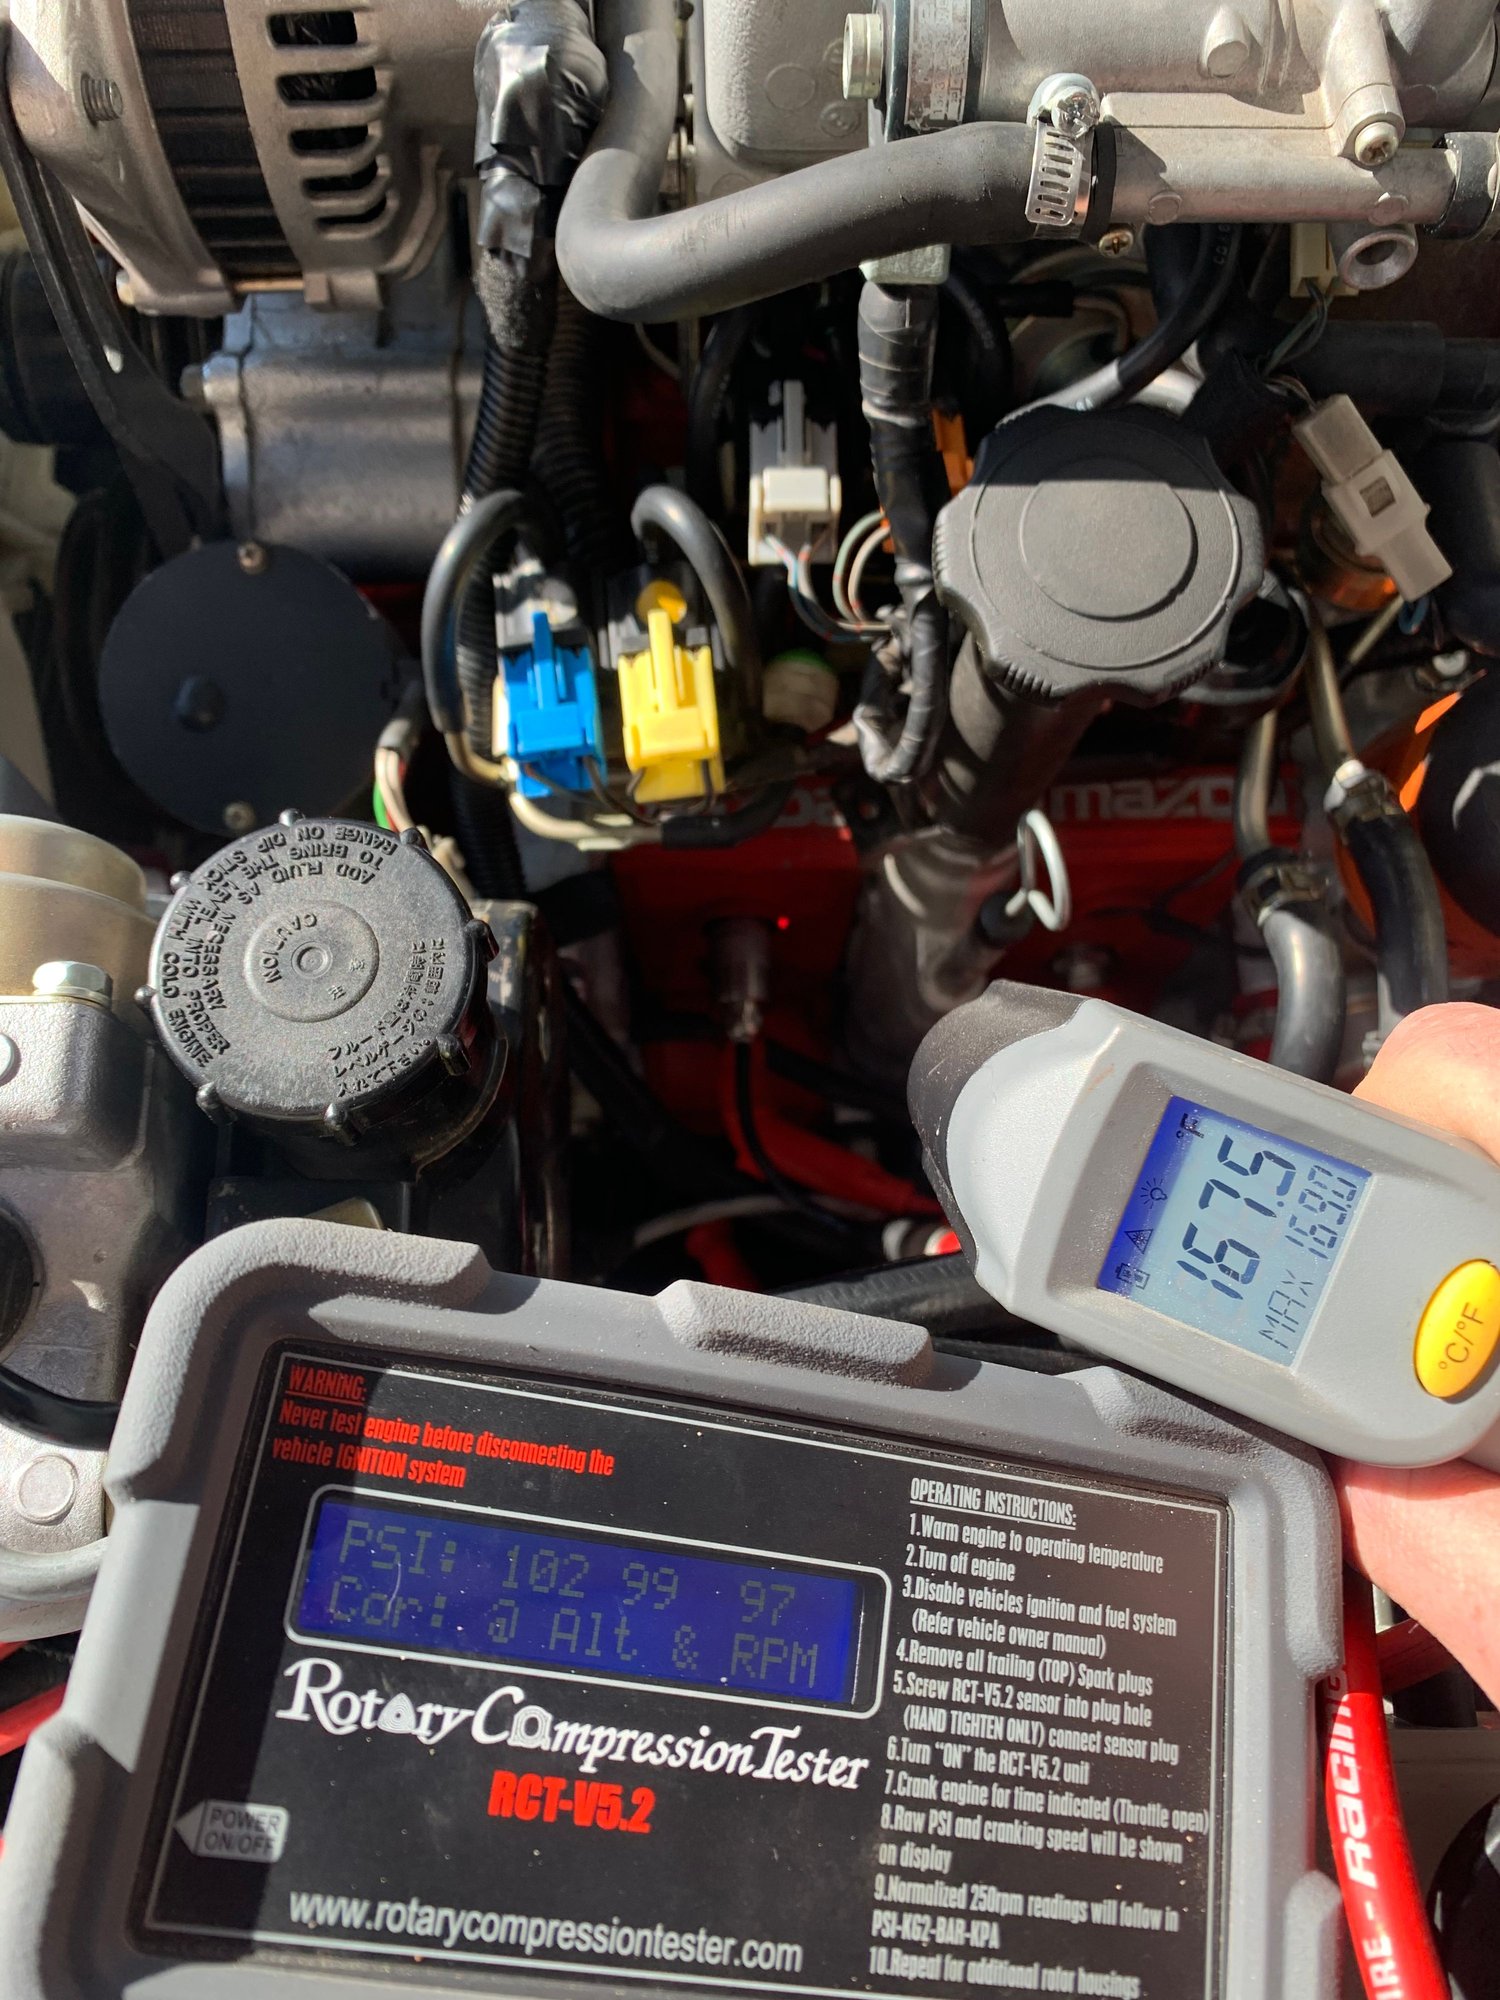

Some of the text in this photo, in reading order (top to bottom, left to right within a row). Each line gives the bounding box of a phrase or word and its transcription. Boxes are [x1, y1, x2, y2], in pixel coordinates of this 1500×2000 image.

[258, 832, 286, 852] DIP
[288, 842, 348, 860] BRING
[297, 826, 324, 841] ON
[334, 826, 398, 855] RANGE
[271, 861, 322, 883] FLUID
[336, 861, 376, 885] ADD
[360, 850, 384, 871] TO
[180, 938, 204, 978] INTO
[261, 911, 318, 984] CAUTION
[161, 952, 179, 999] COLD
[167, 1008, 214, 1068] ENGINE
[186, 989, 231, 1056] PROPER
[1177, 1135, 1297, 1301] 167.5
[1259, 1272, 1314, 1349] MAX
[290, 1364, 367, 1401] WARNING:
[272, 1436, 468, 1487] vehicle IGNITION system
[279, 1399, 614, 1476] Never test engine before disconnecting the
[910, 1478, 1076, 1526] OPERATING INSTRUCTIONS:
[905, 1544, 1015, 1582] 2.Turn off engine
[909, 1512, 1163, 1574] 1.Warm engine to operating temperature
[339, 1519, 794, 1627] PSI: 102 99 97
[902, 1574, 1177, 1637] 3.Disable vehicles ignition and fuel system
[550, 1609, 637, 1661] Alt
[732, 1633, 818, 1688] RPM
[912, 1608, 1106, 1659] (Refer vehicle owner manual)
[896, 1638, 1153, 1696] 4.Remove all trailing (TOP) Spark plugs
[893, 1670, 1152, 1728] 5.Screw RCT-V5.2 sensor into plug hole
[887, 1735, 931, 1765] 6.Turn
[974, 1747, 996, 1773] the
[999, 1750, 1061, 1782] RCT-V5.2
[1063, 1759, 1090, 1785] unit
[903, 1704, 1179, 1766] (HAND TIGHTEN ONLY) connect sensor plug
[211, 1809, 280, 1834] POWER
[488, 1770, 655, 1833] RCT-V5.2
[884, 1768, 1209, 1835] 7.Crank engine for time indicated (Throttle open)
[879, 1840, 952, 1874] on display
[881, 1802, 1182, 1863] 8.Raw PSI and cranking speed will be shown
[289, 1892, 802, 1972] www.rotarycompressiontester.com
[1027, 1890, 1088, 1924] readings
[1091, 1898, 1117, 1924] will
[1119, 1901, 1162, 1931] follow
[1165, 1906, 1179, 1932] in
[944, 1954, 964, 1984] for
[1078, 1967, 1141, 2000] housings
